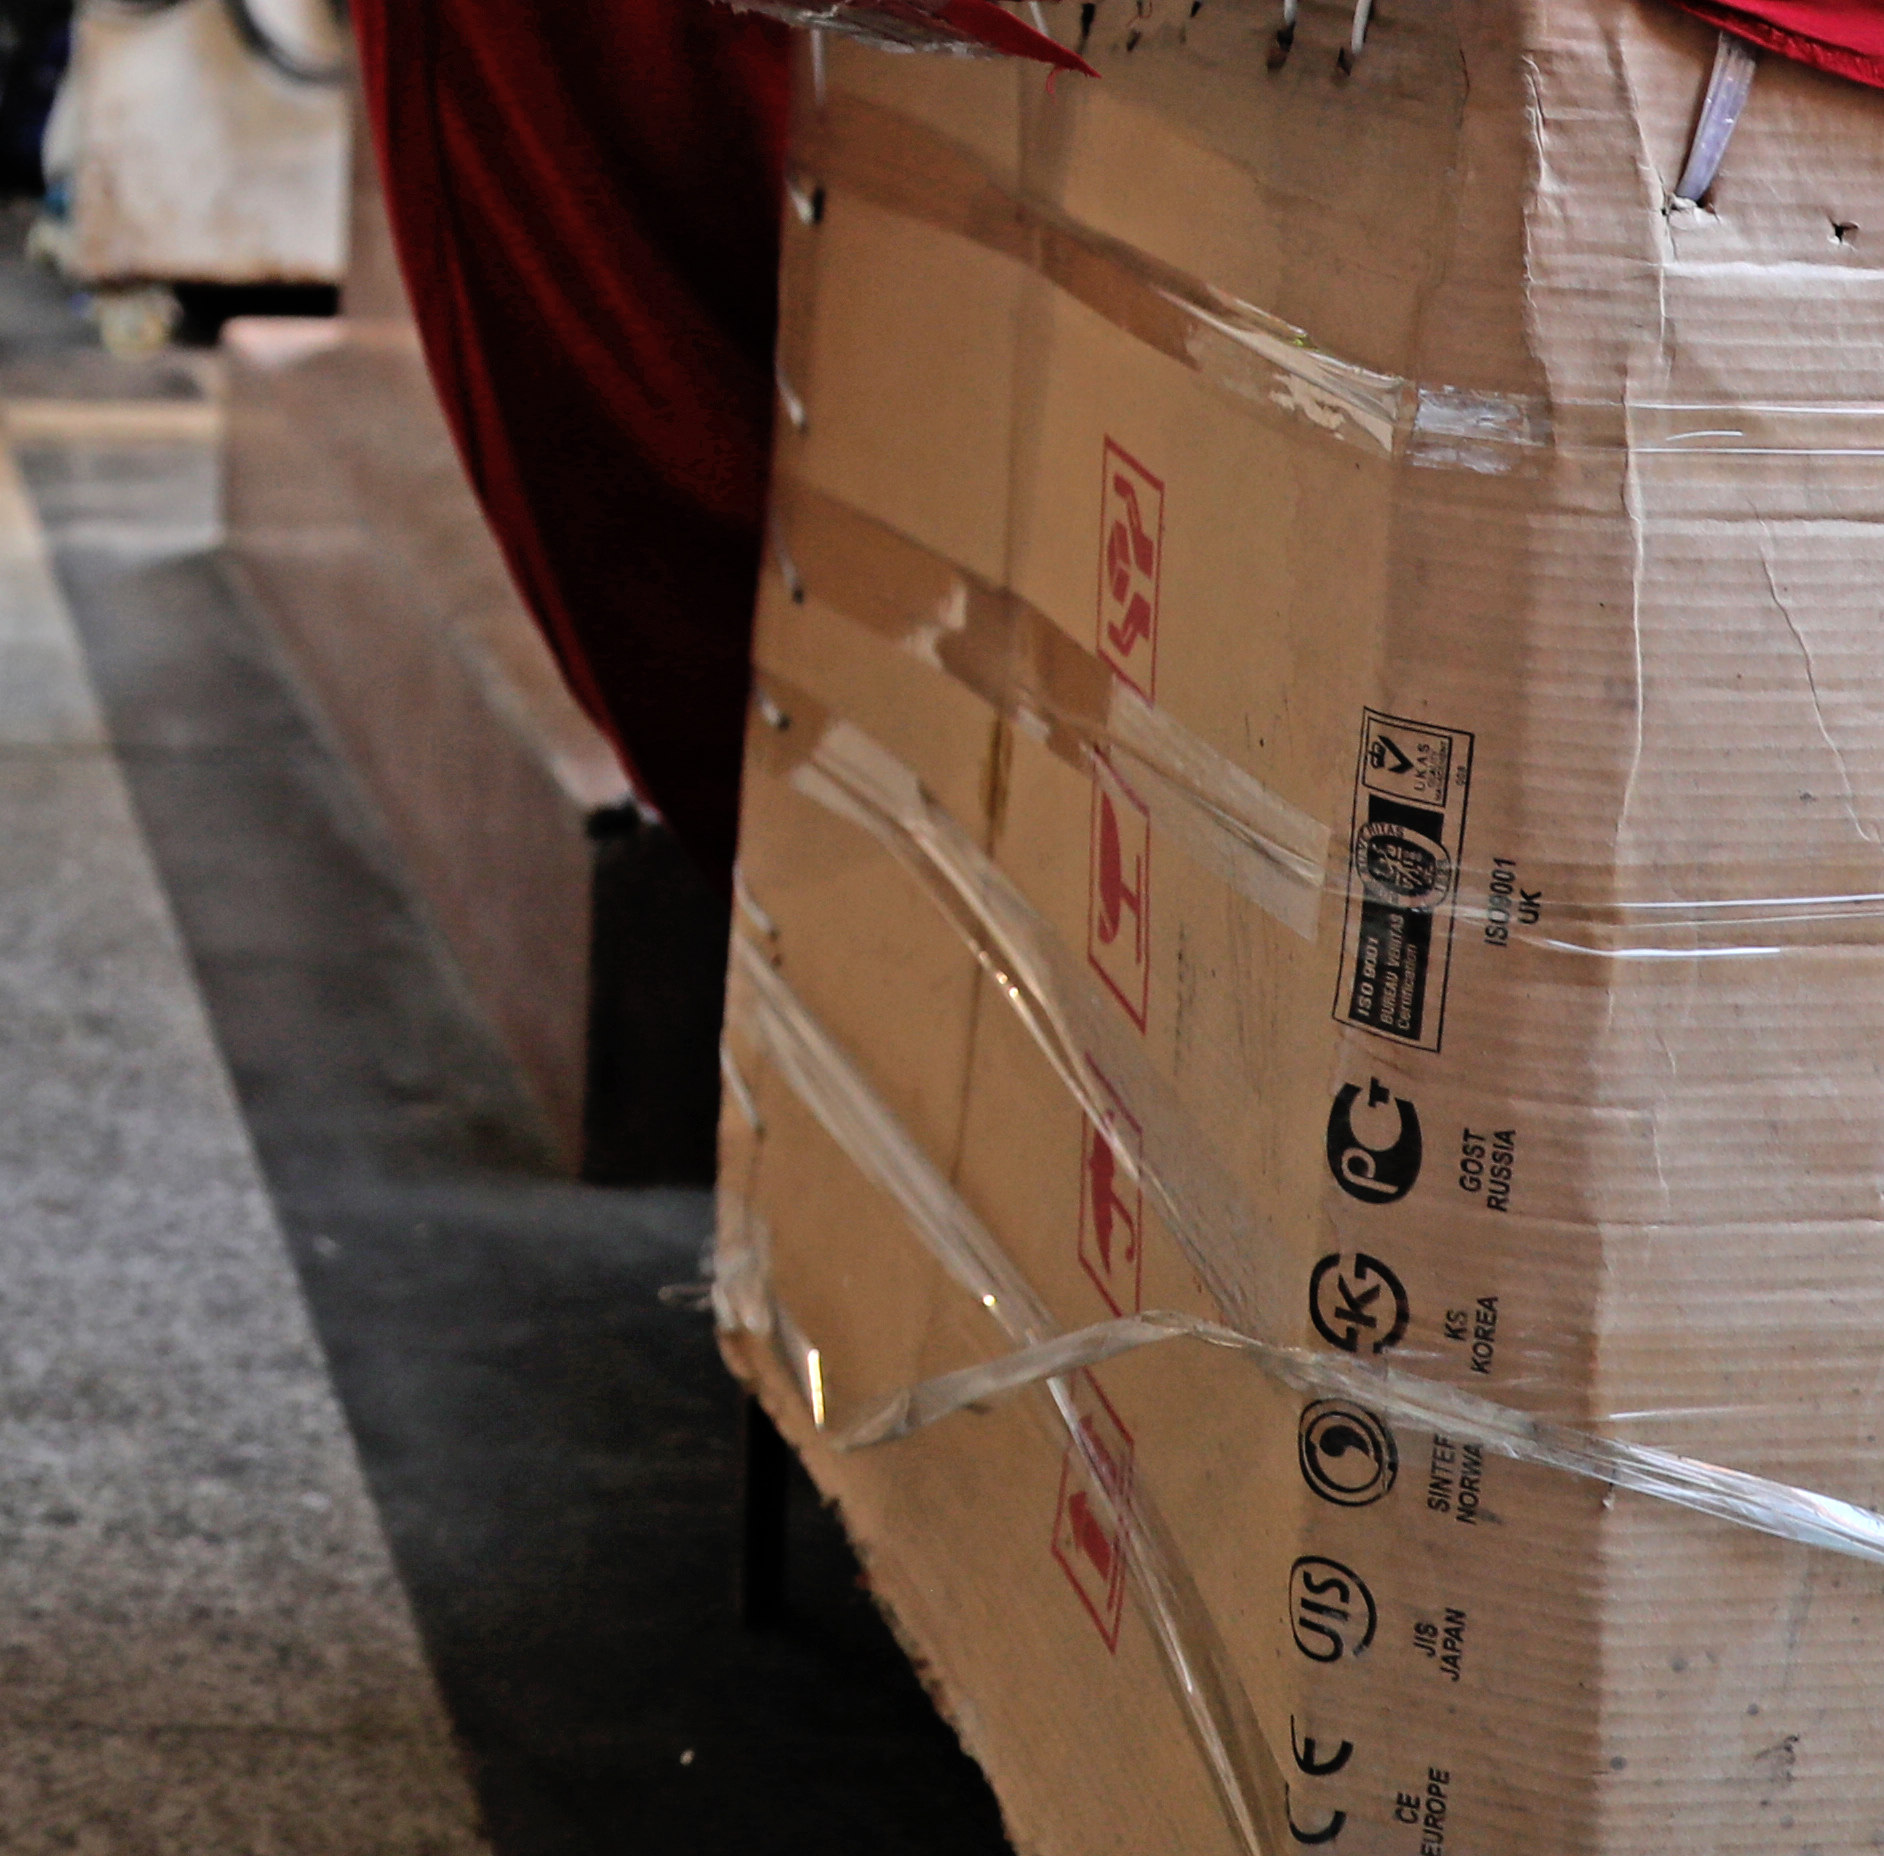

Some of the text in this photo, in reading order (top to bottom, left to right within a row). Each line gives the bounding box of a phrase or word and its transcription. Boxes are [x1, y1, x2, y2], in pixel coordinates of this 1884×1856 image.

[1413, 743, 1431, 792] UKAS
[1484, 857, 1516, 948] ISO9001
[1517, 888, 1542, 925] UK
[1356, 981, 1375, 1017] ISO
[1379, 971, 1399, 1025] BUREAU
[1458, 1127, 1486, 1192] GOST
[1486, 1129, 1517, 1213] RUSSIA
[1444, 1309, 1468, 1341] KS
[1470, 1295, 1499, 1375] KOREA
[1427, 1433, 1455, 1513] SINTEF
[1456, 1443, 1484, 1525] NORWA
[1413, 1621, 1439, 1658] JIS
[1439, 1607, 1467, 1682] JAPAN
[1394, 1792, 1421, 1825] CE
[1420, 1767, 1451, 1856] EUROPE
